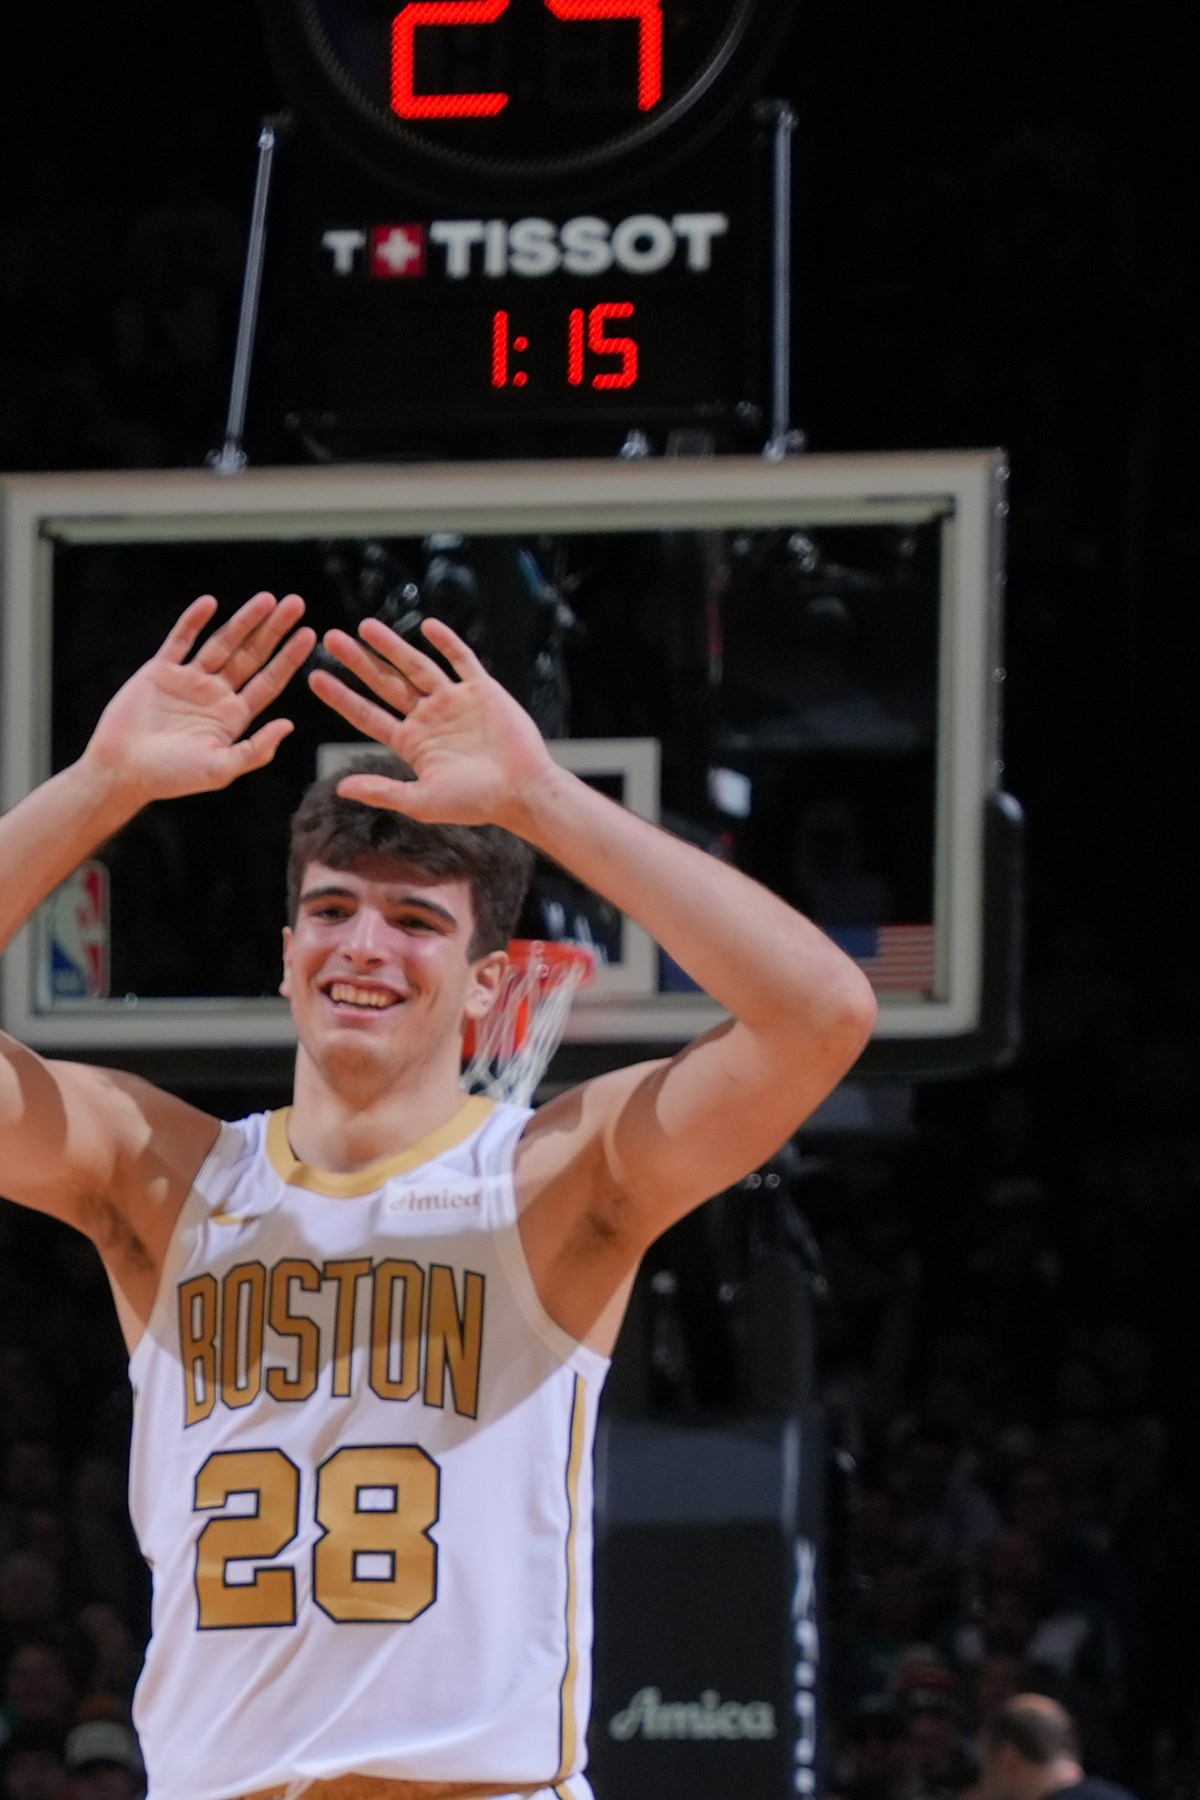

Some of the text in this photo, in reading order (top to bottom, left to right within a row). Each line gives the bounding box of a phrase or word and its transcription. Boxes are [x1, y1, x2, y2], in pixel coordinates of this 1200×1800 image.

[429, 212, 728, 279] TISSOT
[388, 1187, 481, 1212] Amica
[177, 1257, 486, 1430] BOSTON
[191, 1444, 441, 1632] 28
[608, 1685, 778, 1742] Amica
